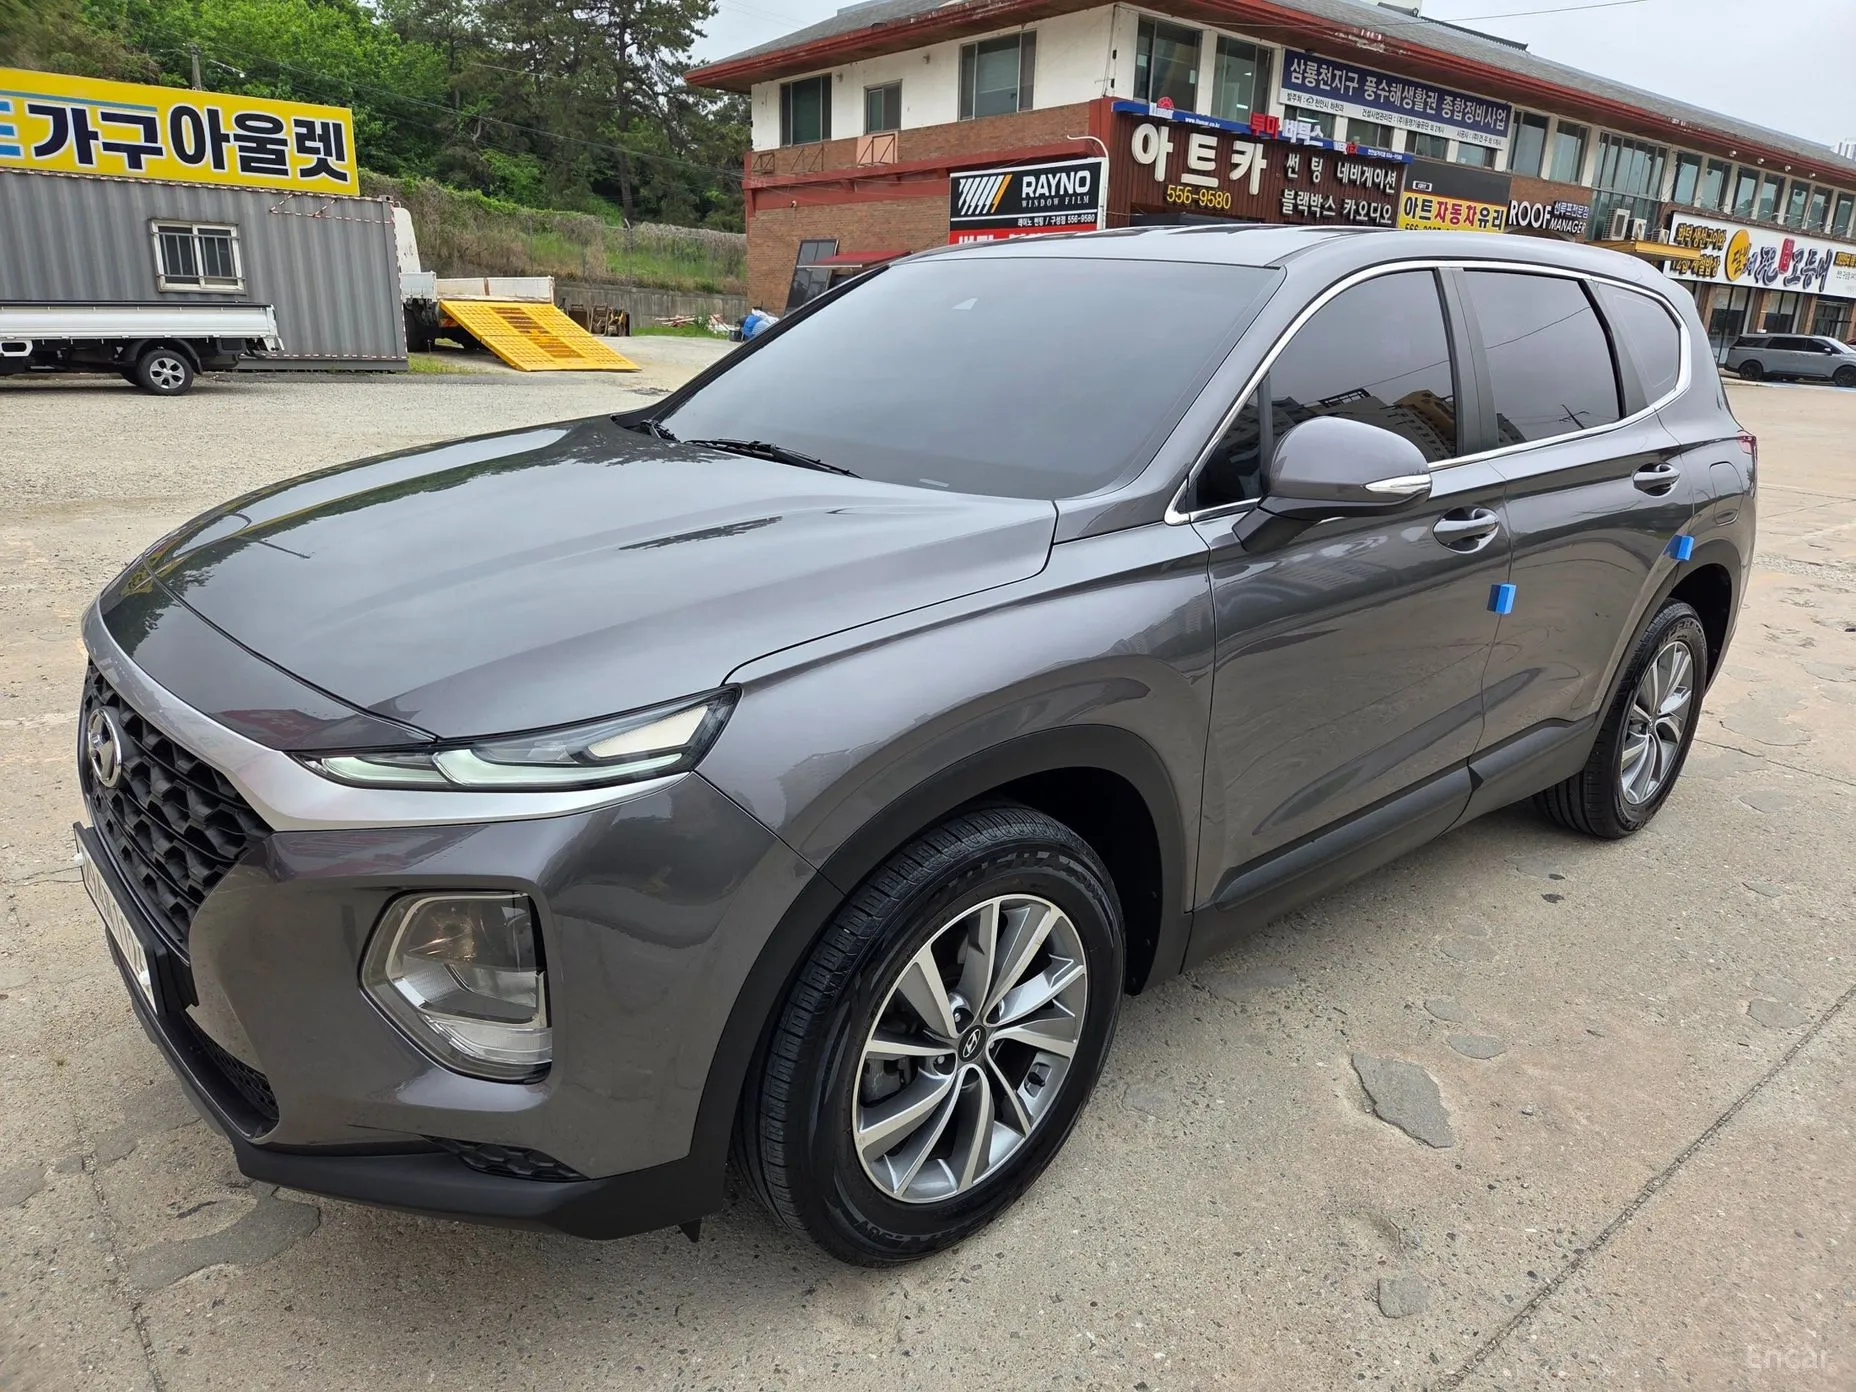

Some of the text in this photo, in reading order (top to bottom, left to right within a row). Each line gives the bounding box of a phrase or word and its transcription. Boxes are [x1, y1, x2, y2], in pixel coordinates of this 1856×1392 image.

[1290, 58, 1507, 131] 삼룡천지구 풍수해생활권 종합정비사업
[27, 103, 349, 183] 가구아울렛
[1131, 123, 1267, 195] 아트카
[1021, 170, 1091, 198] RAYNO
[1337, 161, 1397, 194] 네비게이션
[1022, 195, 1090, 208] WINDOW FILM
[1166, 184, 1232, 210] 556-9580
[1281, 188, 1392, 224] 블랙박스 카오디오
[1067, 214, 1095, 224] 556-9580
[1508, 200, 1552, 229] ROOF
[1549, 217, 1587, 234] MANAGER
